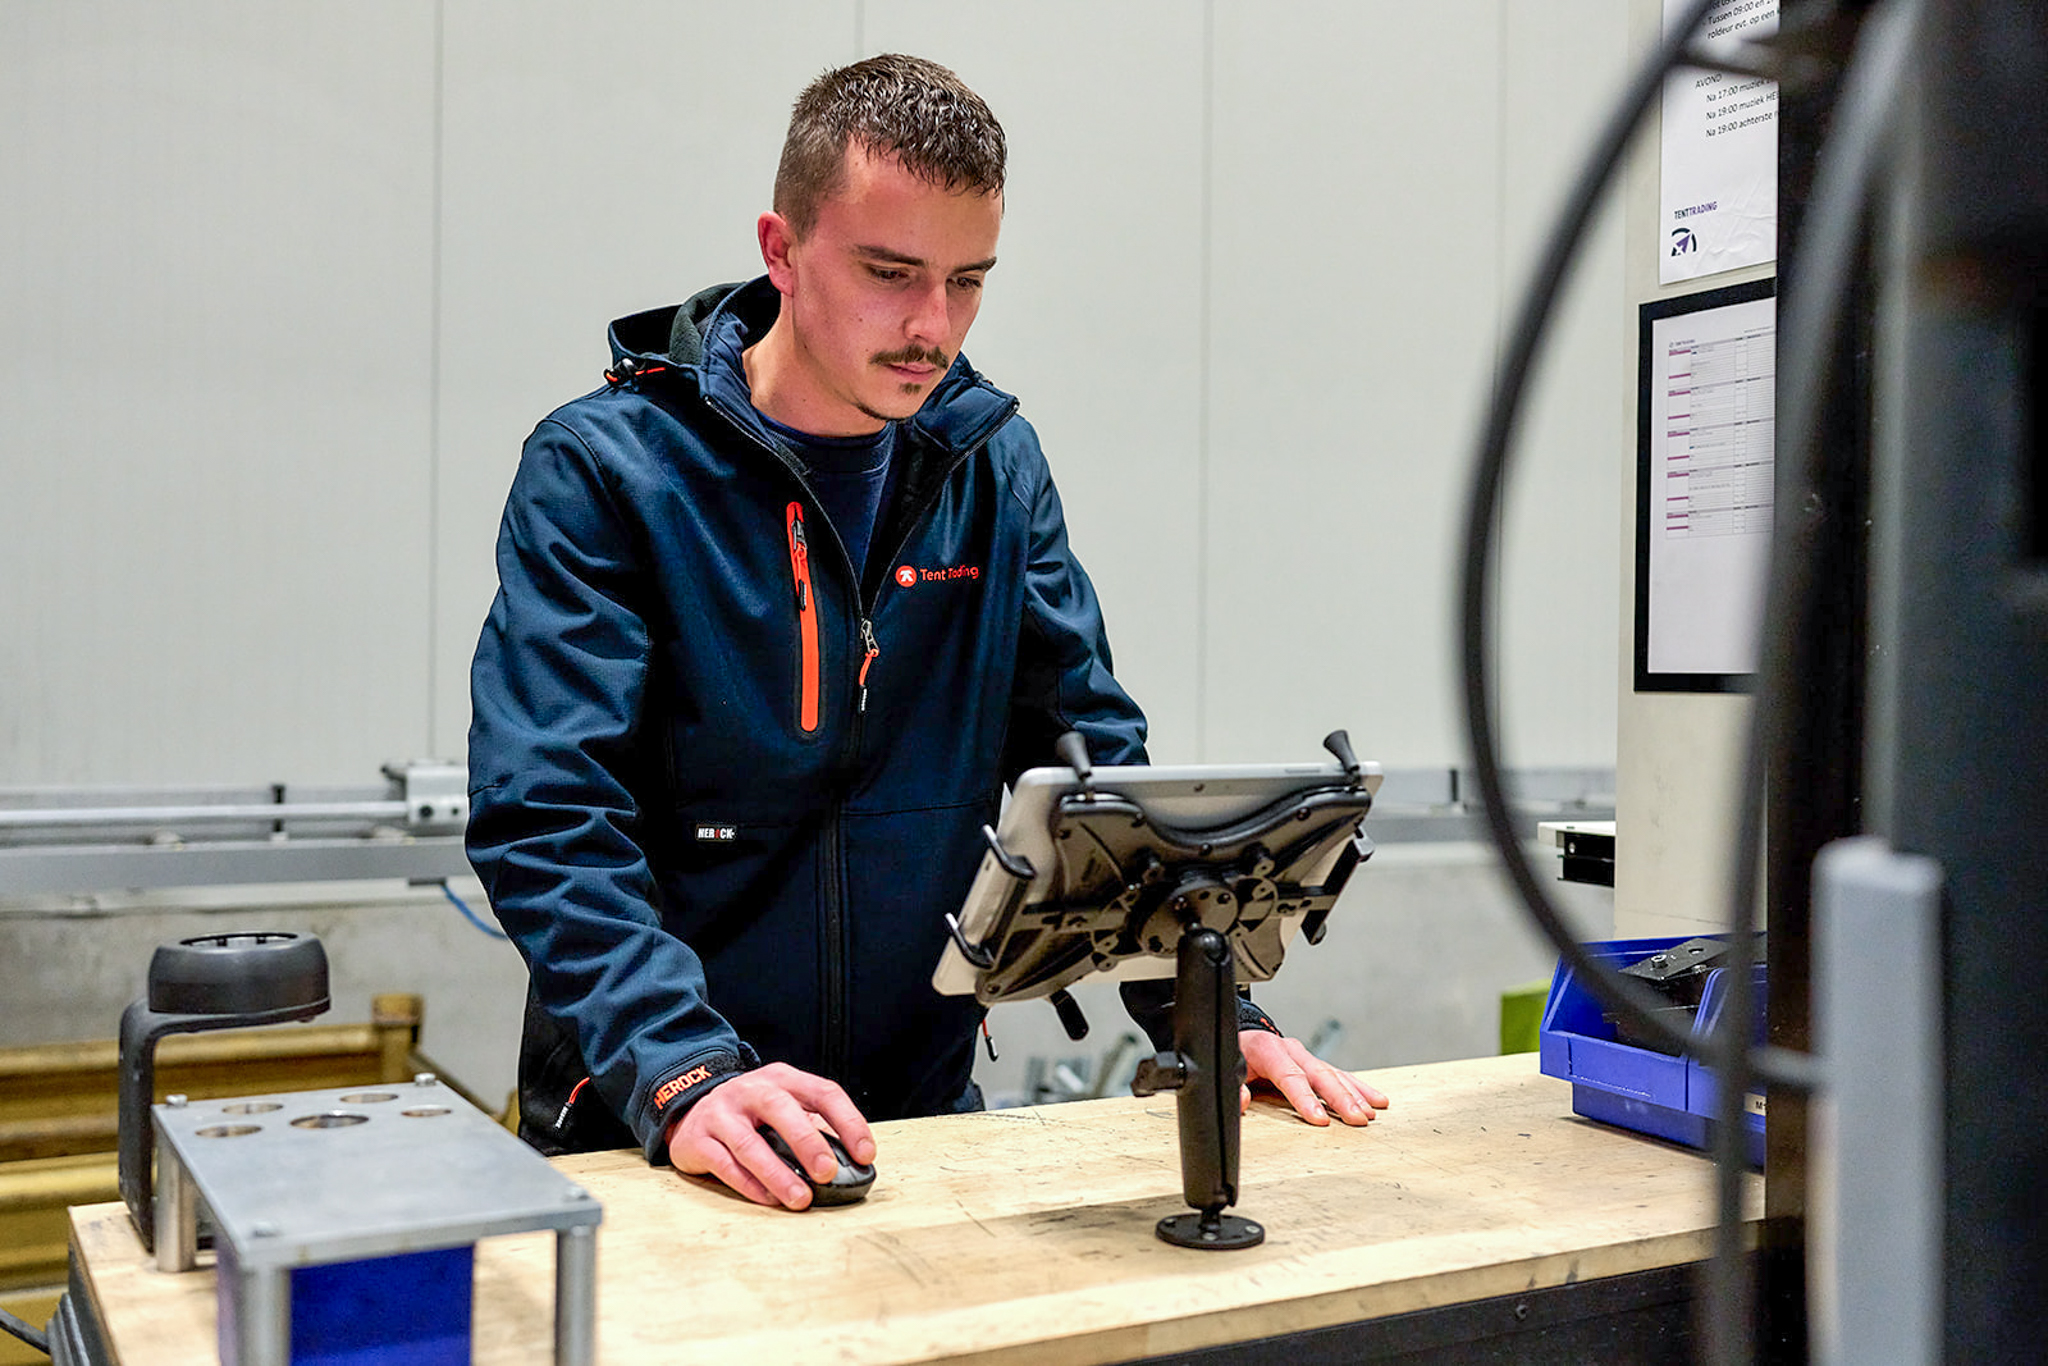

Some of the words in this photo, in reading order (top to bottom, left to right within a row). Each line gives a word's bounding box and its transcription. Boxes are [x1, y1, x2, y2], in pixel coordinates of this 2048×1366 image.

[1707, 24, 1734, 39] roldeur
[1750, 15, 1760, 24] op
[1761, 10, 1775, 21] een
[1708, 11, 1733, 25] Tussen
[1733, 1, 1754, 16] 09:00
[1695, 73, 1722, 89] AVOND
[1707, 93, 1717, 102] Na
[1718, 85, 1738, 100] 17:00
[1706, 111, 1716, 120] Na
[1718, 103, 1738, 117] 19:00
[1739, 96, 1764, 111] muziek
[1706, 128, 1716, 137] Na
[1718, 121, 1738, 135] 19:00
[1739, 112, 1773, 129] achterste
[920, 567, 946, 581] Tent
[948, 564, 980, 580] Tading
[653, 1064, 712, 1110] HEROCK
